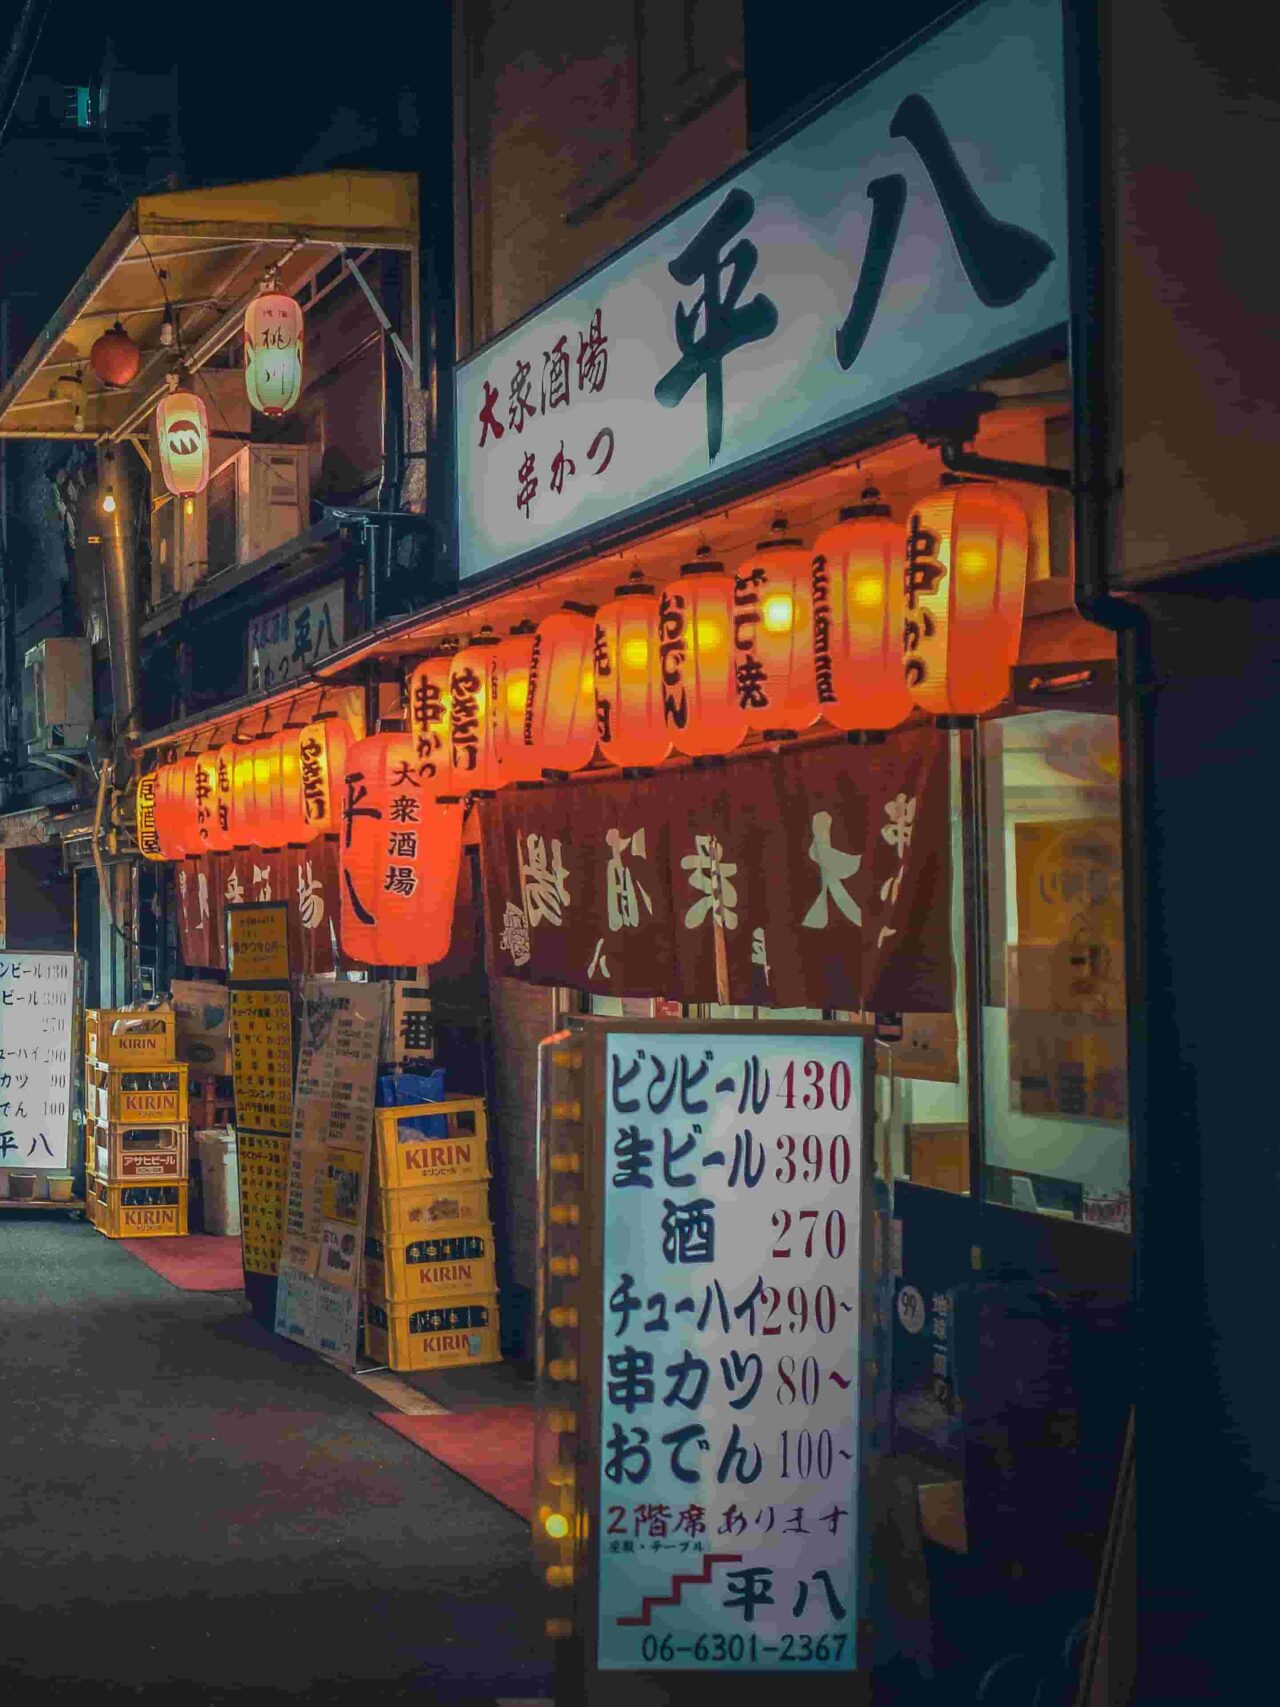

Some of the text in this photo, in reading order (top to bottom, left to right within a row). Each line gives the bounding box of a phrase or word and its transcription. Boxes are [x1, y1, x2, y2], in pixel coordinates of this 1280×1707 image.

[654, 93, 1056, 467] 平八
[477, 306, 609, 447] 大衆酒場
[517, 426, 615, 519] 串かつ
[904, 511, 948, 688] 串かつ
[659, 591, 687, 730] おでん
[414, 674, 447, 779] 串かつ
[451, 667, 482, 771] やきとり
[300, 736, 326, 821] やきとり
[384, 761, 421, 897] 大衆酒場
[119, 1038, 156, 1049] KIRIN
[42, 1101, 65, 1117] 100
[50, 1073, 66, 1089] 90
[125, 1095, 175, 1110] KIRIN
[613, 1049, 852, 1115] ビンビール 430
[123, 1155, 176, 1166] アサヒビール
[405, 1144, 471, 1170] KIRIN
[613, 1124, 851, 1189] 生ビール 390
[125, 1210, 174, 1225] KIRIN
[662, 1198, 847, 1265] 酒 270
[419, 1264, 472, 1284] KIRIN
[610, 1273, 763, 1336] チューハイ
[608, 1345, 763, 1414] 串カツ
[605, 1422, 763, 1484] おでん
[723, 1567, 847, 1622] 平八
[642, 1633, 848, 1663] 06-6301-2367
